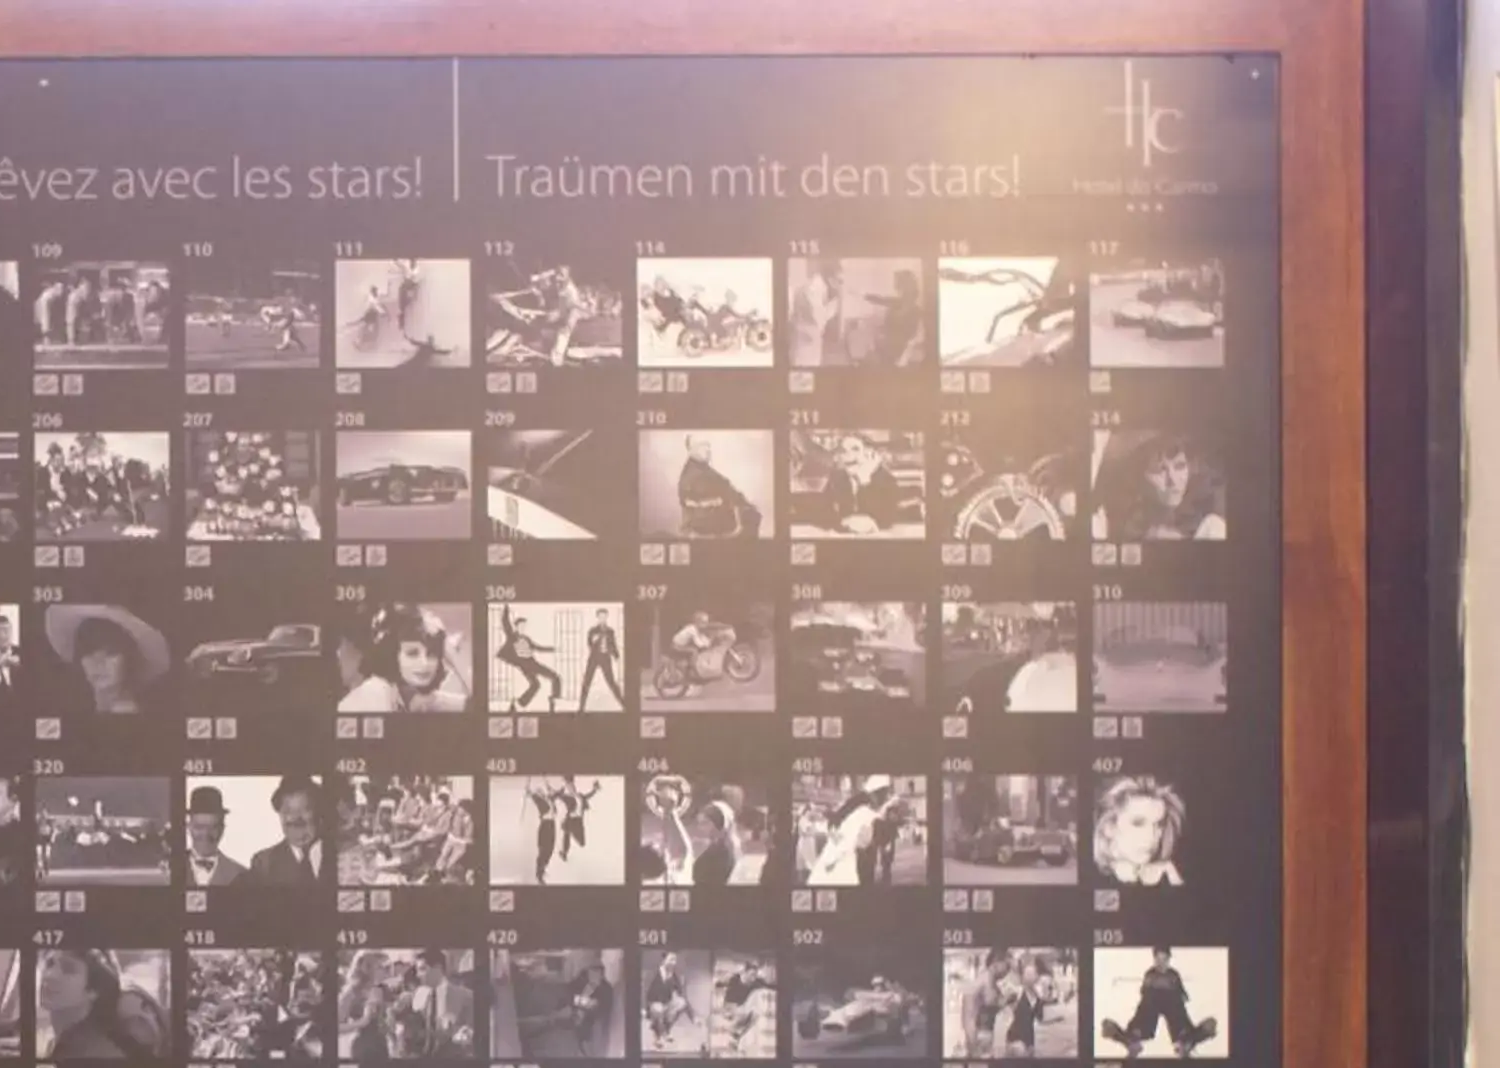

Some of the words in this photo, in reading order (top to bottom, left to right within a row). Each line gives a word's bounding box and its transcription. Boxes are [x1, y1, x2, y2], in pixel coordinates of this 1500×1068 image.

[112, 165, 217, 199] avec
[233, 155, 292, 199] les
[307, 155, 423, 199] stars!
[486, 155, 693, 198] Traümen
[710, 155, 787, 198] mit
[801, 153, 889, 198] den
[906, 153, 1021, 198] stars!
[32, 244, 63, 258] 109
[183, 243, 212, 257] 110
[335, 241, 363, 256] 111
[636, 241, 665, 255] 114
[32, 413, 63, 428] 206
[183, 413, 212, 427] 207
[335, 413, 365, 426] 208
[484, 411, 515, 426] 209
[791, 410, 820, 425] 211
[1090, 411, 1120, 425] 214
[33, 587, 63, 601] 303
[184, 586, 214, 601] 304
[336, 586, 366, 601] 305
[486, 586, 516, 600] 306
[637, 584, 668, 599] 307
[791, 584, 821, 599] 308
[942, 584, 972, 599] 309
[33, 760, 64, 774] 320
[183, 759, 212, 773] 401
[336, 759, 366, 773] 402
[486, 758, 516, 773] 403
[637, 758, 668, 772] 404
[791, 758, 823, 772] 405
[942, 758, 973, 772] 406
[1093, 758, 1123, 772] 407
[32, 930, 63, 945] 417
[184, 930, 215, 944] 418
[337, 930, 367, 944] 419
[487, 930, 517, 945] 420
[638, 930, 667, 944] 501
[793, 930, 823, 944] 502
[942, 930, 973, 944] 503
